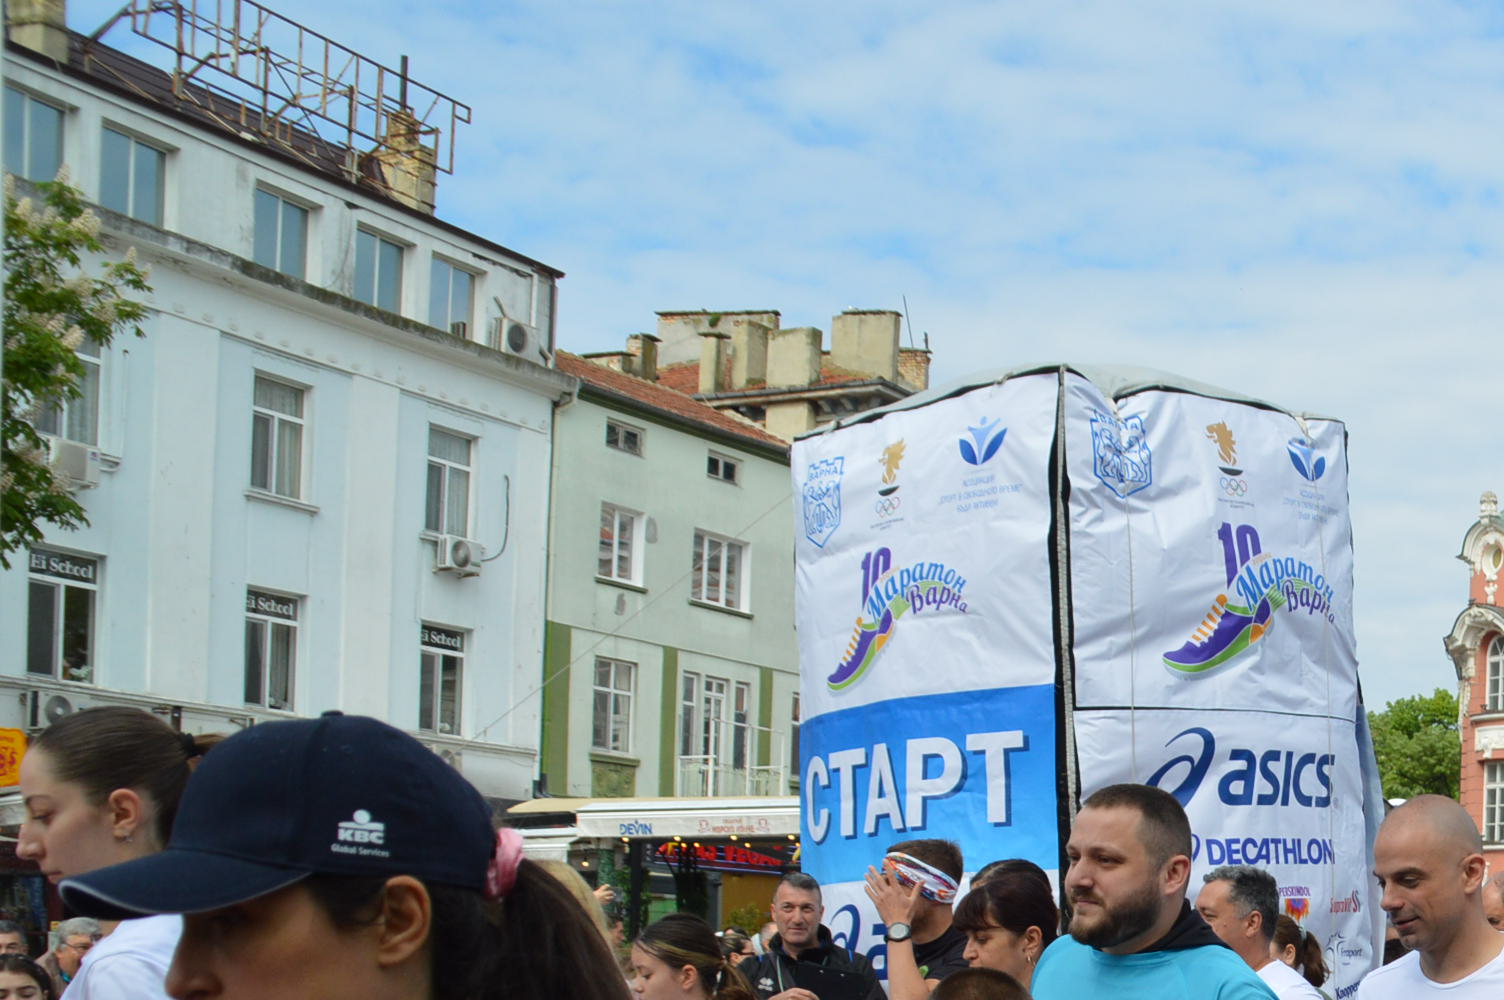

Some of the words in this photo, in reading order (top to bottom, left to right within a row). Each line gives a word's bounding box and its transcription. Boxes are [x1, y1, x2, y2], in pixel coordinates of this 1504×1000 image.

[808, 467, 838, 480] ВАРНА
[50, 557, 94, 579] School
[867, 562, 967, 622] Маратон
[1236, 557, 1334, 612] Маратон
[257, 599, 294, 616] School
[906, 583, 969, 614] Варна
[1281, 578, 1336, 623] Варна
[430, 631, 461, 648] School
[804, 729, 1027, 844] СТАРТ
[338, 828, 385, 844] KBC
[620, 821, 653, 835] DEVIN
[331, 843, 356, 855] Global
[358, 846, 390, 858] Services
[1205, 837, 1336, 865] DECATHLON
